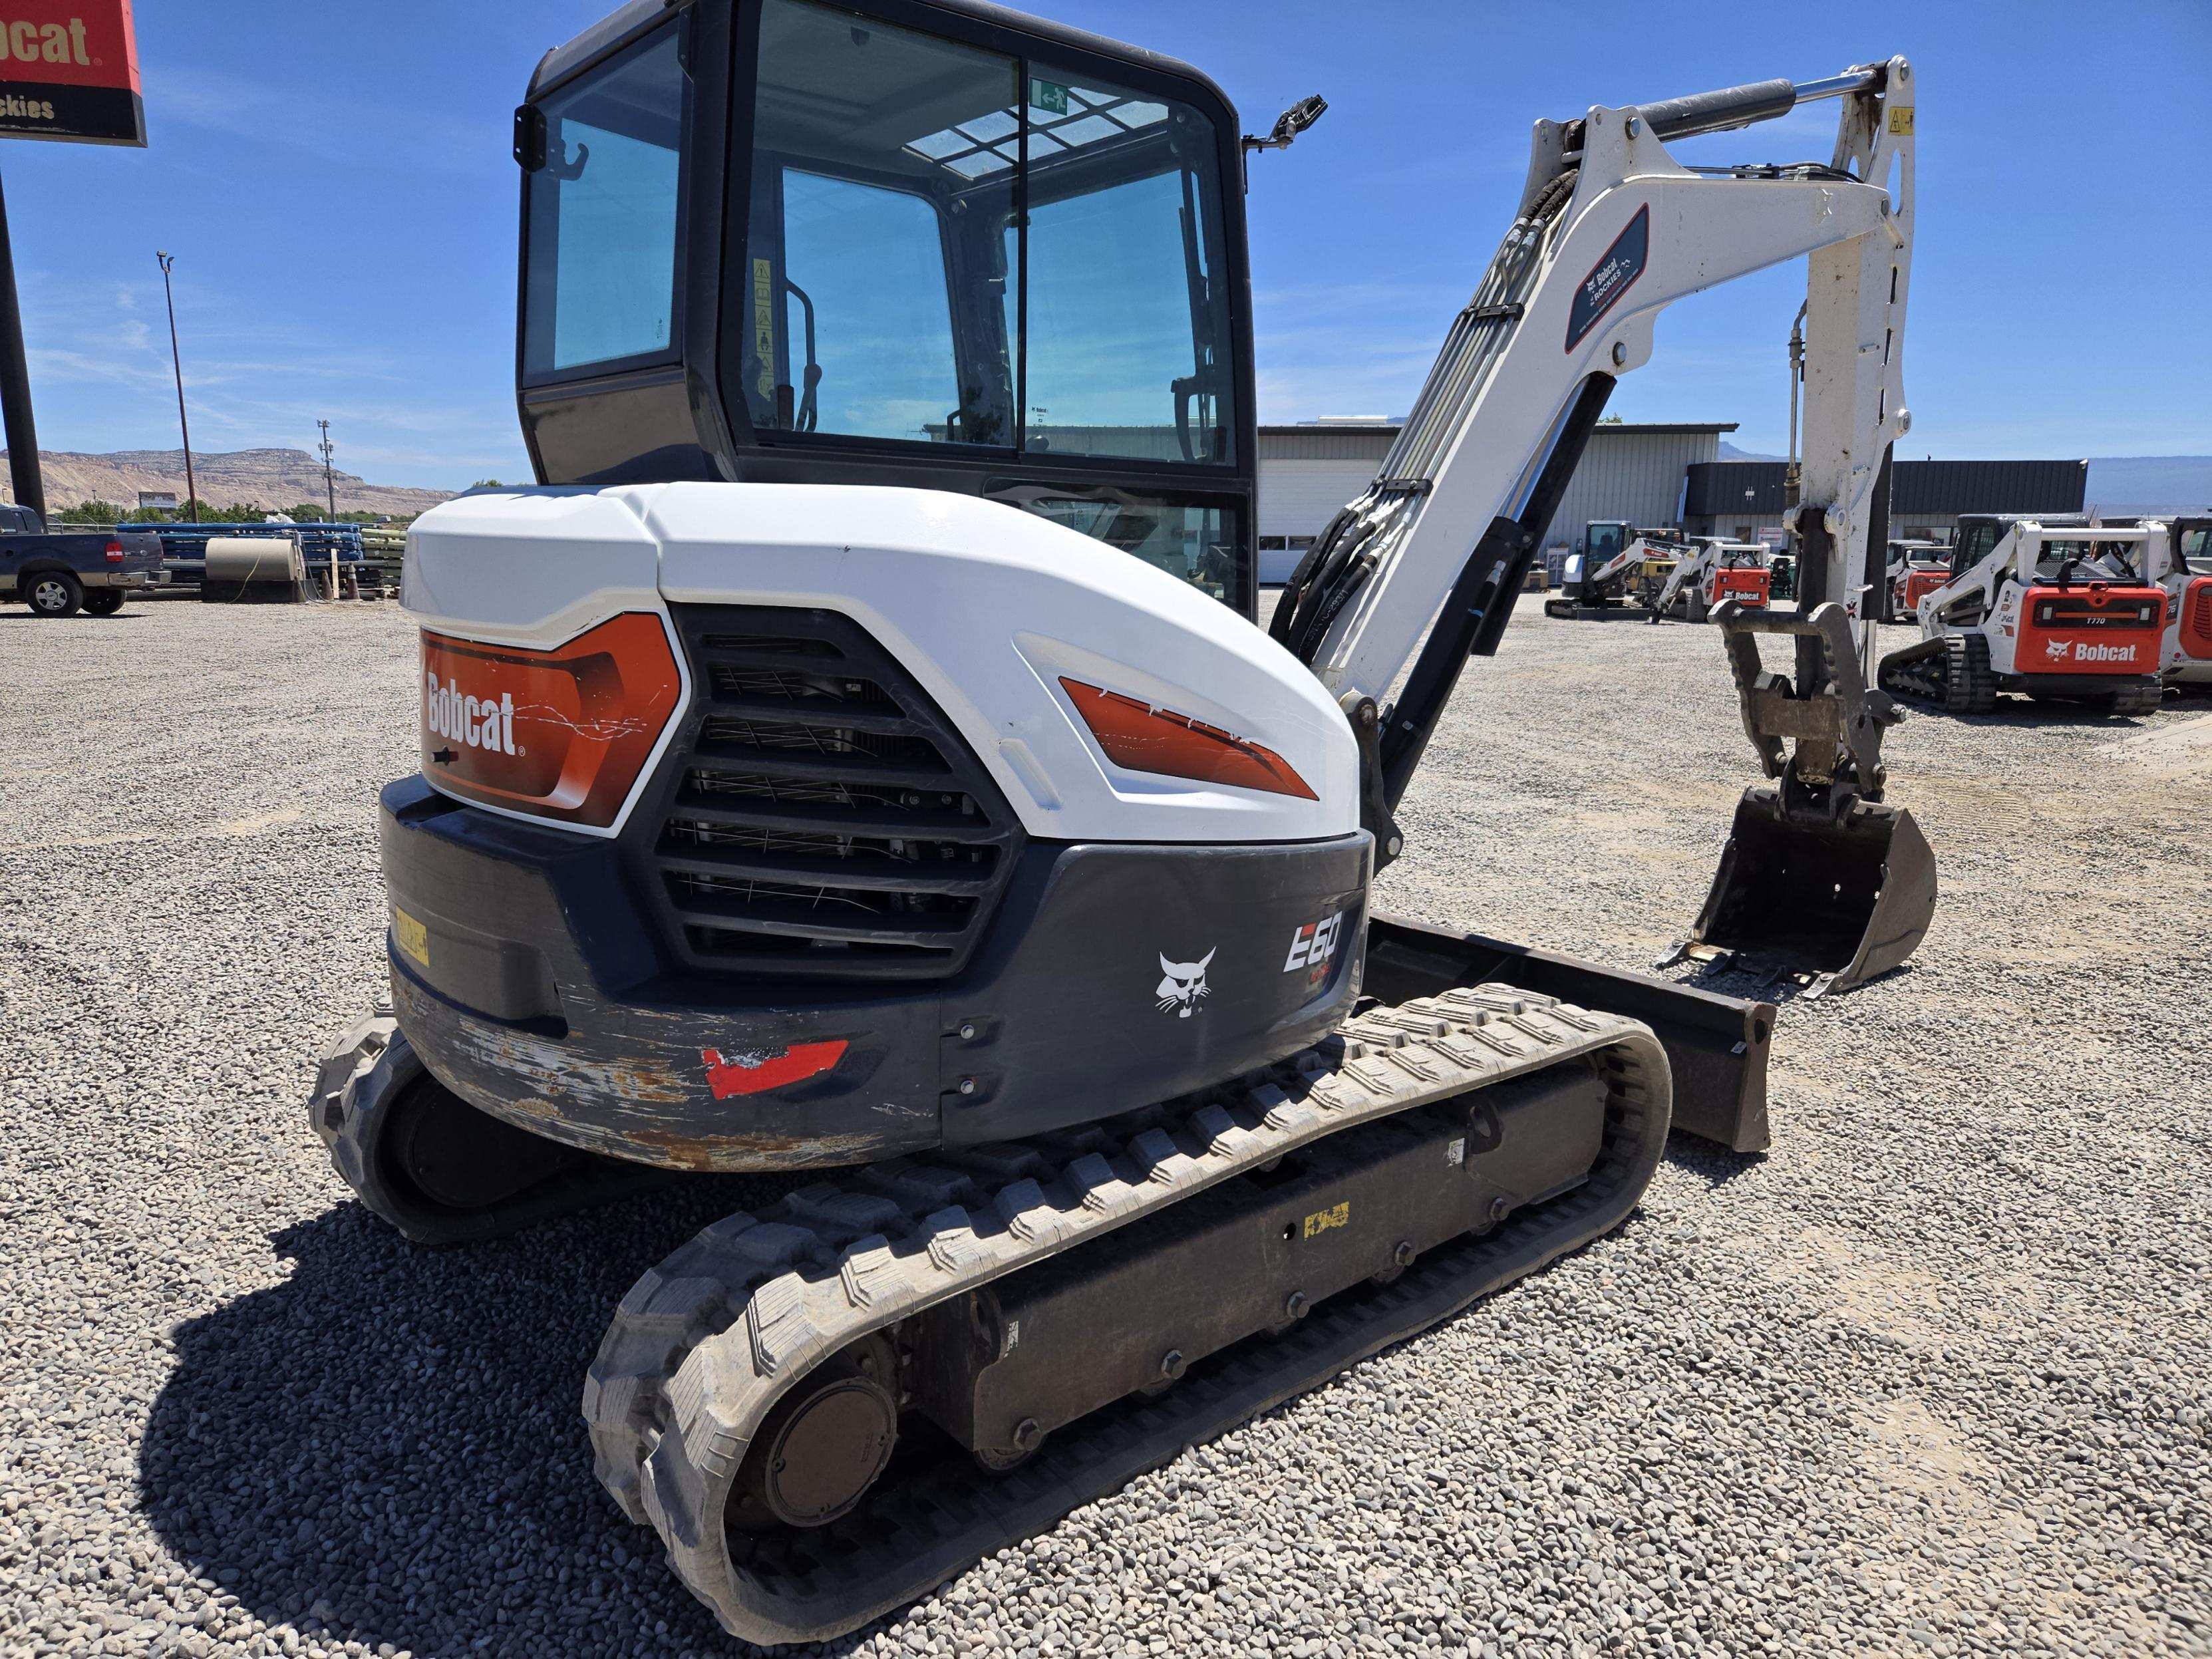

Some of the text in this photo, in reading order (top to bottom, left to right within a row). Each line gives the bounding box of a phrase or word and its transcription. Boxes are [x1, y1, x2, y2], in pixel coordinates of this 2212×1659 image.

[0, 19, 90, 65] cat
[1594, 269, 1622, 301] ROCKIES
[1596, 257, 1618, 285] Bobcat
[2075, 643, 2137, 661] Bobcat
[428, 671, 516, 756] Bobcat
[1283, 911, 1343, 973] E60
